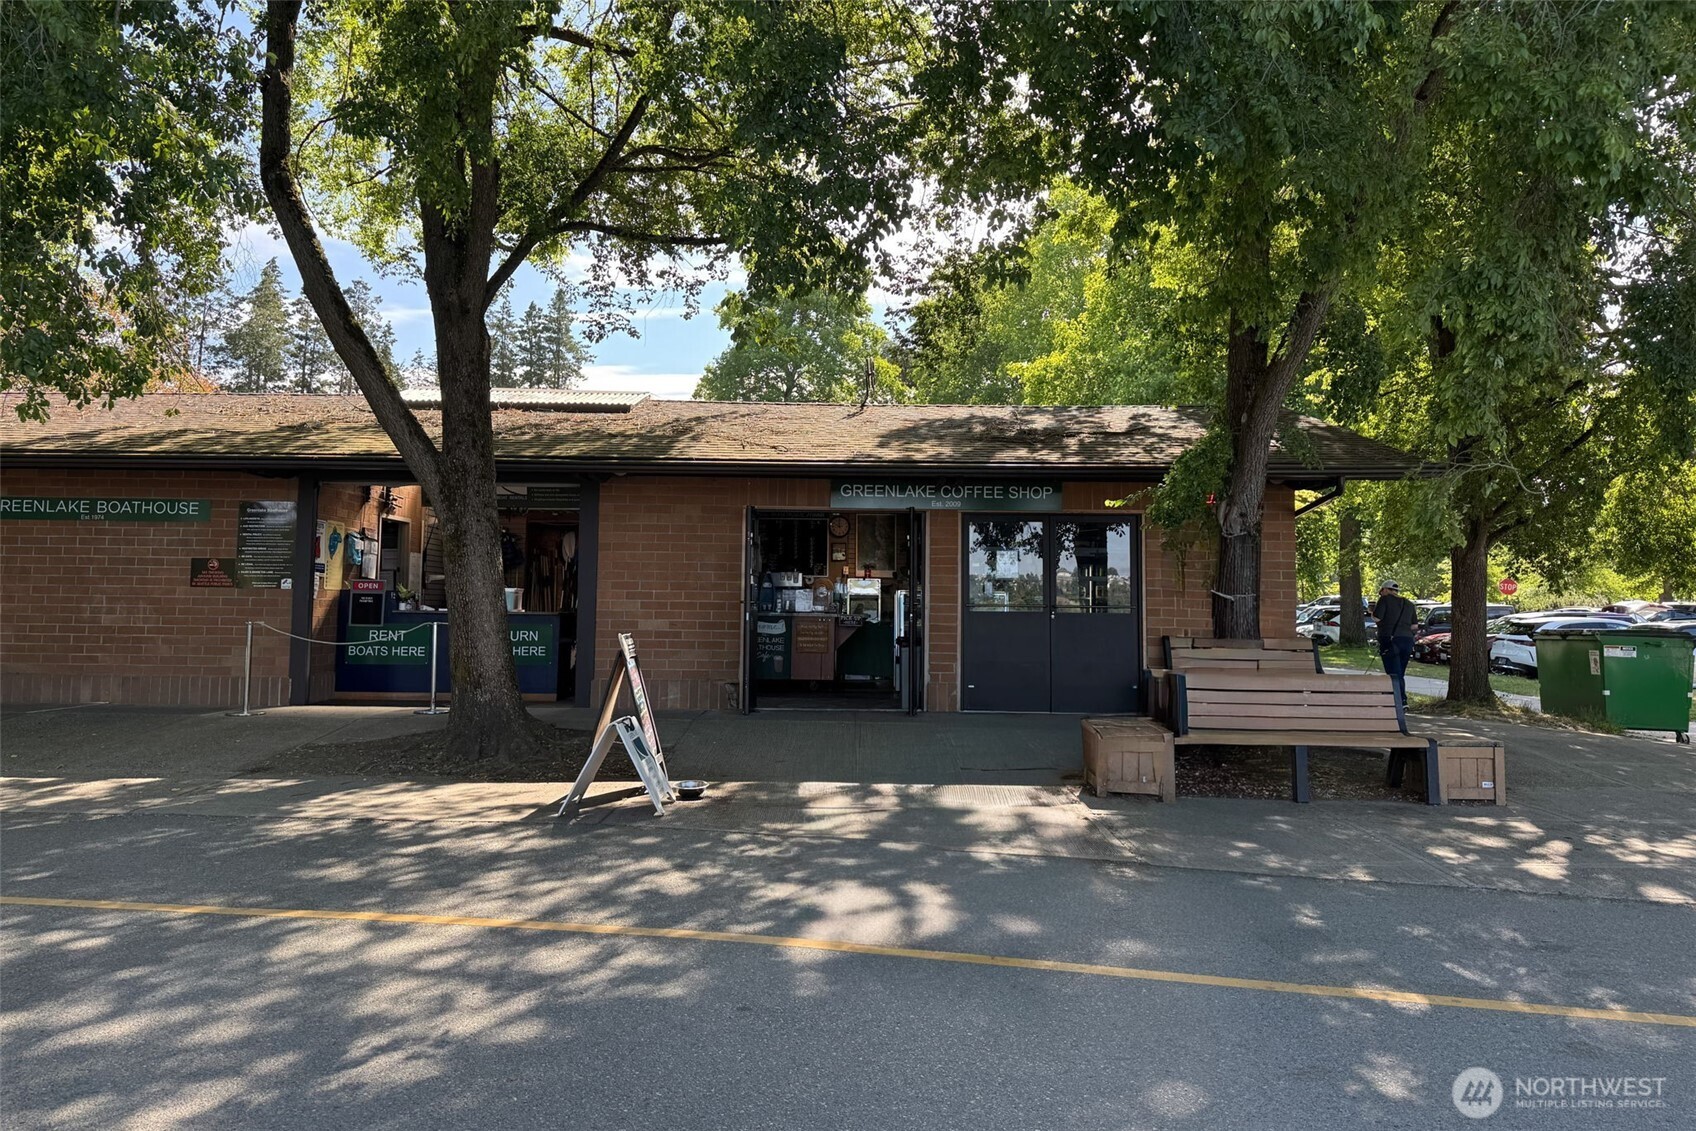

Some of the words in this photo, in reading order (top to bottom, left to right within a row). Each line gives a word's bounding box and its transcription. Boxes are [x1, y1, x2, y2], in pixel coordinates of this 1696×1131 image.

[840, 484, 935, 498] GREENLAKE
[940, 486, 1003, 499] COFFEE
[1008, 487, 1054, 500] SHOP
[0, 499, 90, 513] REENLAKE
[96, 500, 200, 515] BOATHOUSE
[1500, 583, 1517, 591] STOP
[369, 630, 405, 642] RENT
[510, 630, 539, 641] URN
[348, 646, 388, 656] BOATS
[391, 646, 426, 656] HERE
[513, 646, 546, 656] HERE
